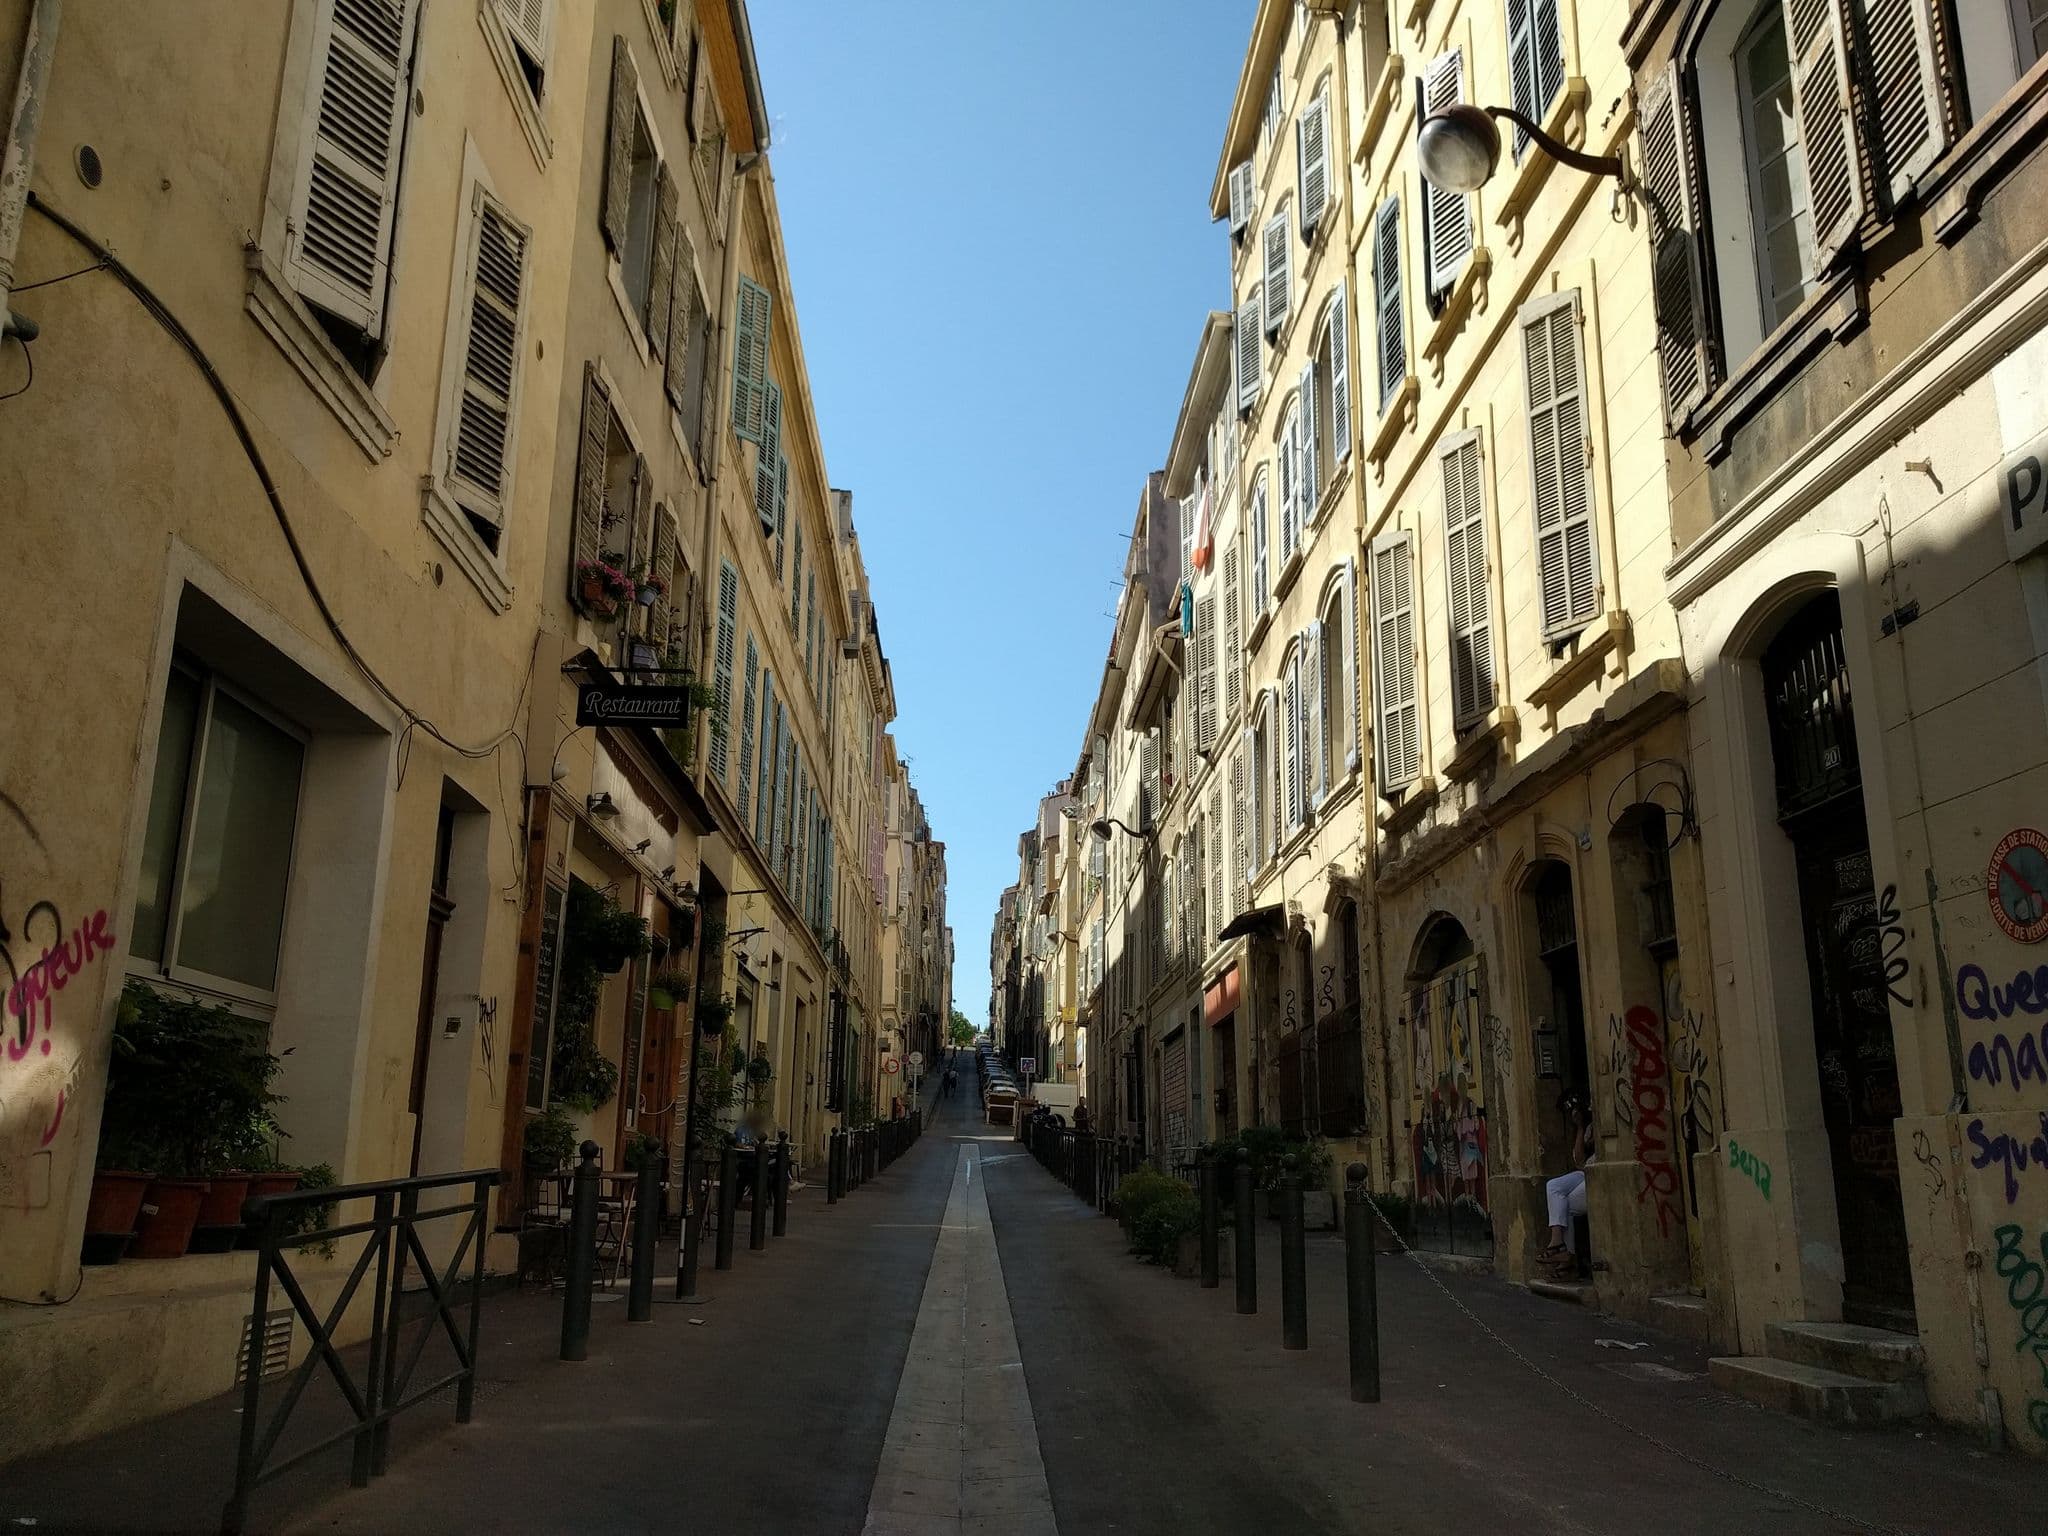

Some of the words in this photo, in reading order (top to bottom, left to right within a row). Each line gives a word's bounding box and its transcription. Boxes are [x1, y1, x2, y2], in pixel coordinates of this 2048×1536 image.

[584, 691, 681, 718] Restaurant
[1988, 839, 2010, 890] DEFENSE
[2007, 832, 2020, 849] DE
[2020, 831, 2048, 859] STATIO
[1990, 896, 2015, 935] SORTIE
[2014, 924, 2026, 940] DE
